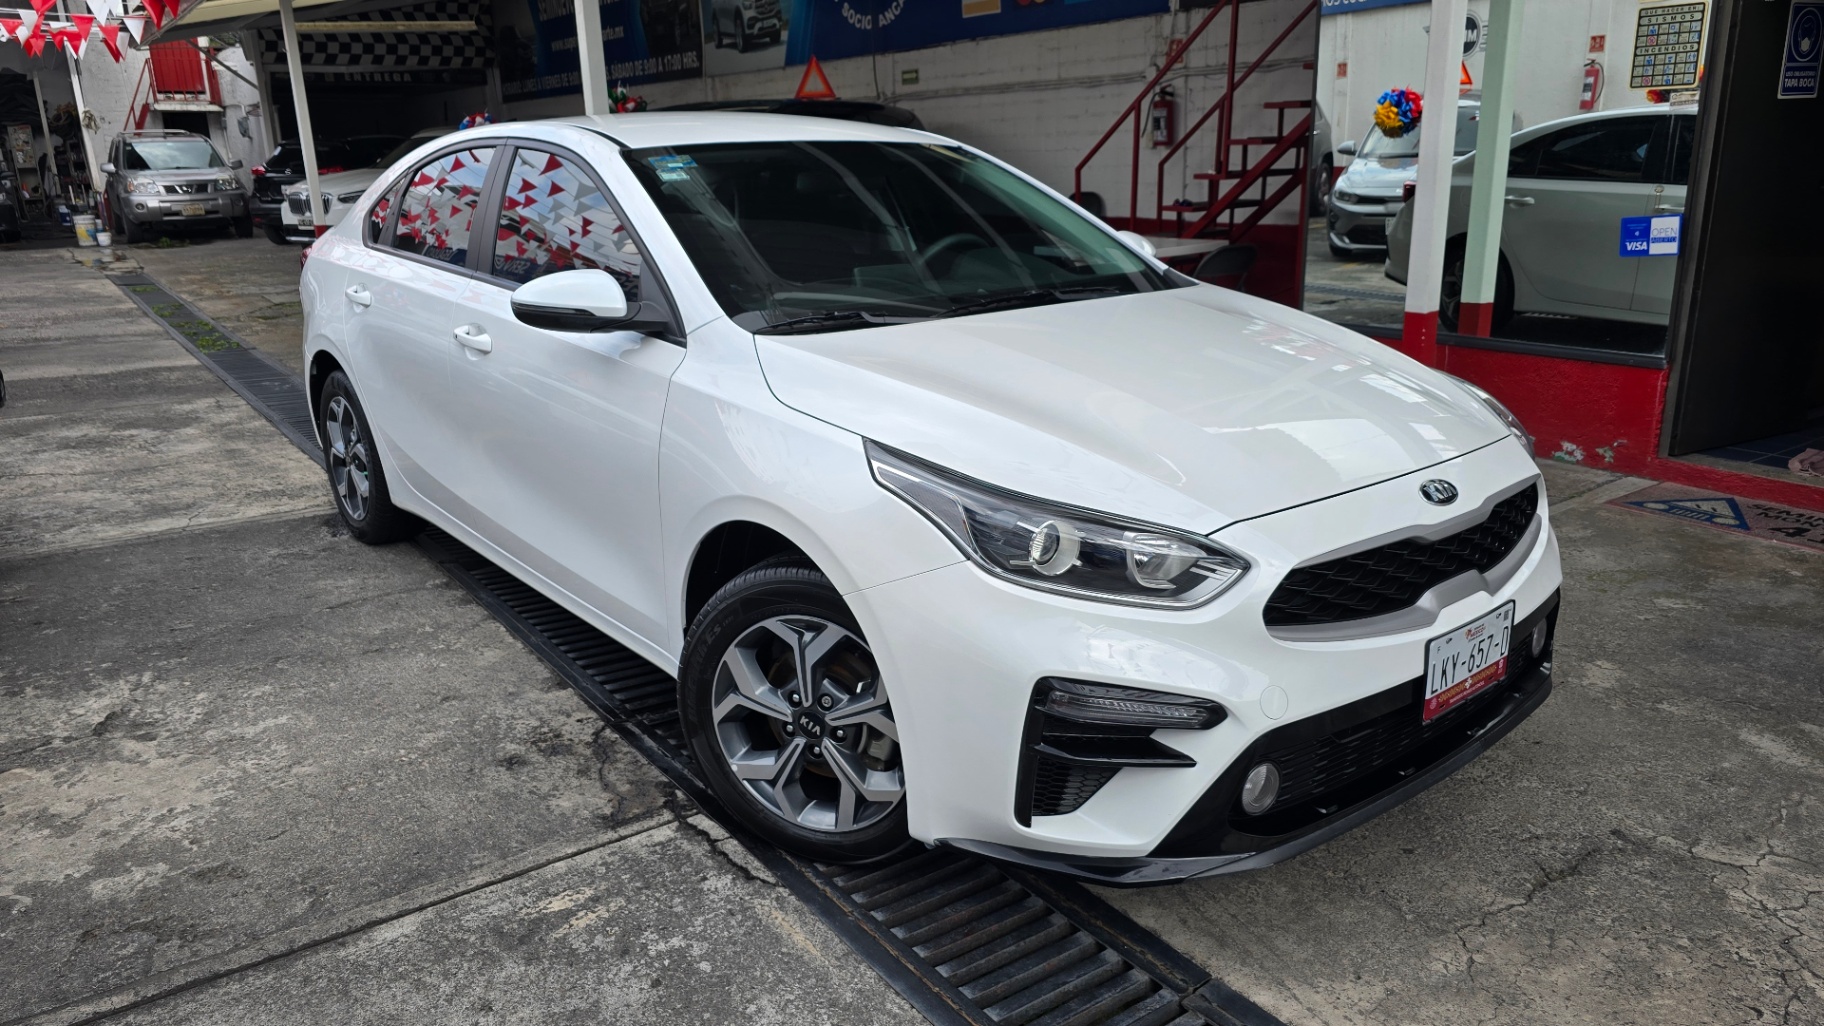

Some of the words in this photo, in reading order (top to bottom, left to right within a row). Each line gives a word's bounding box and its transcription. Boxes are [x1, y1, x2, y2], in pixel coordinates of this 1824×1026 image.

[842, 2, 872, 30] SOCIO
[1647, 13, 1695, 24] SISMOS
[1639, 44, 1695, 54] INCENDIOS
[634, 60, 643, 76] DE
[644, 57, 657, 75] 9:00
[658, 56, 663, 73] A
[664, 53, 682, 71] 17:00
[683, 50, 700, 69] HRS.
[344, 72, 412, 82] ENTREGA
[1784, 78, 1798, 88] TAPA
[1799, 78, 1815, 88] BOCA
[1651, 227, 1677, 237] OPEN
[1625, 241, 1648, 251] VISA
[1422, 481, 1458, 503] KIA
[1430, 625, 1509, 696] LKY-657-D
[800, 715, 821, 736] KIA
